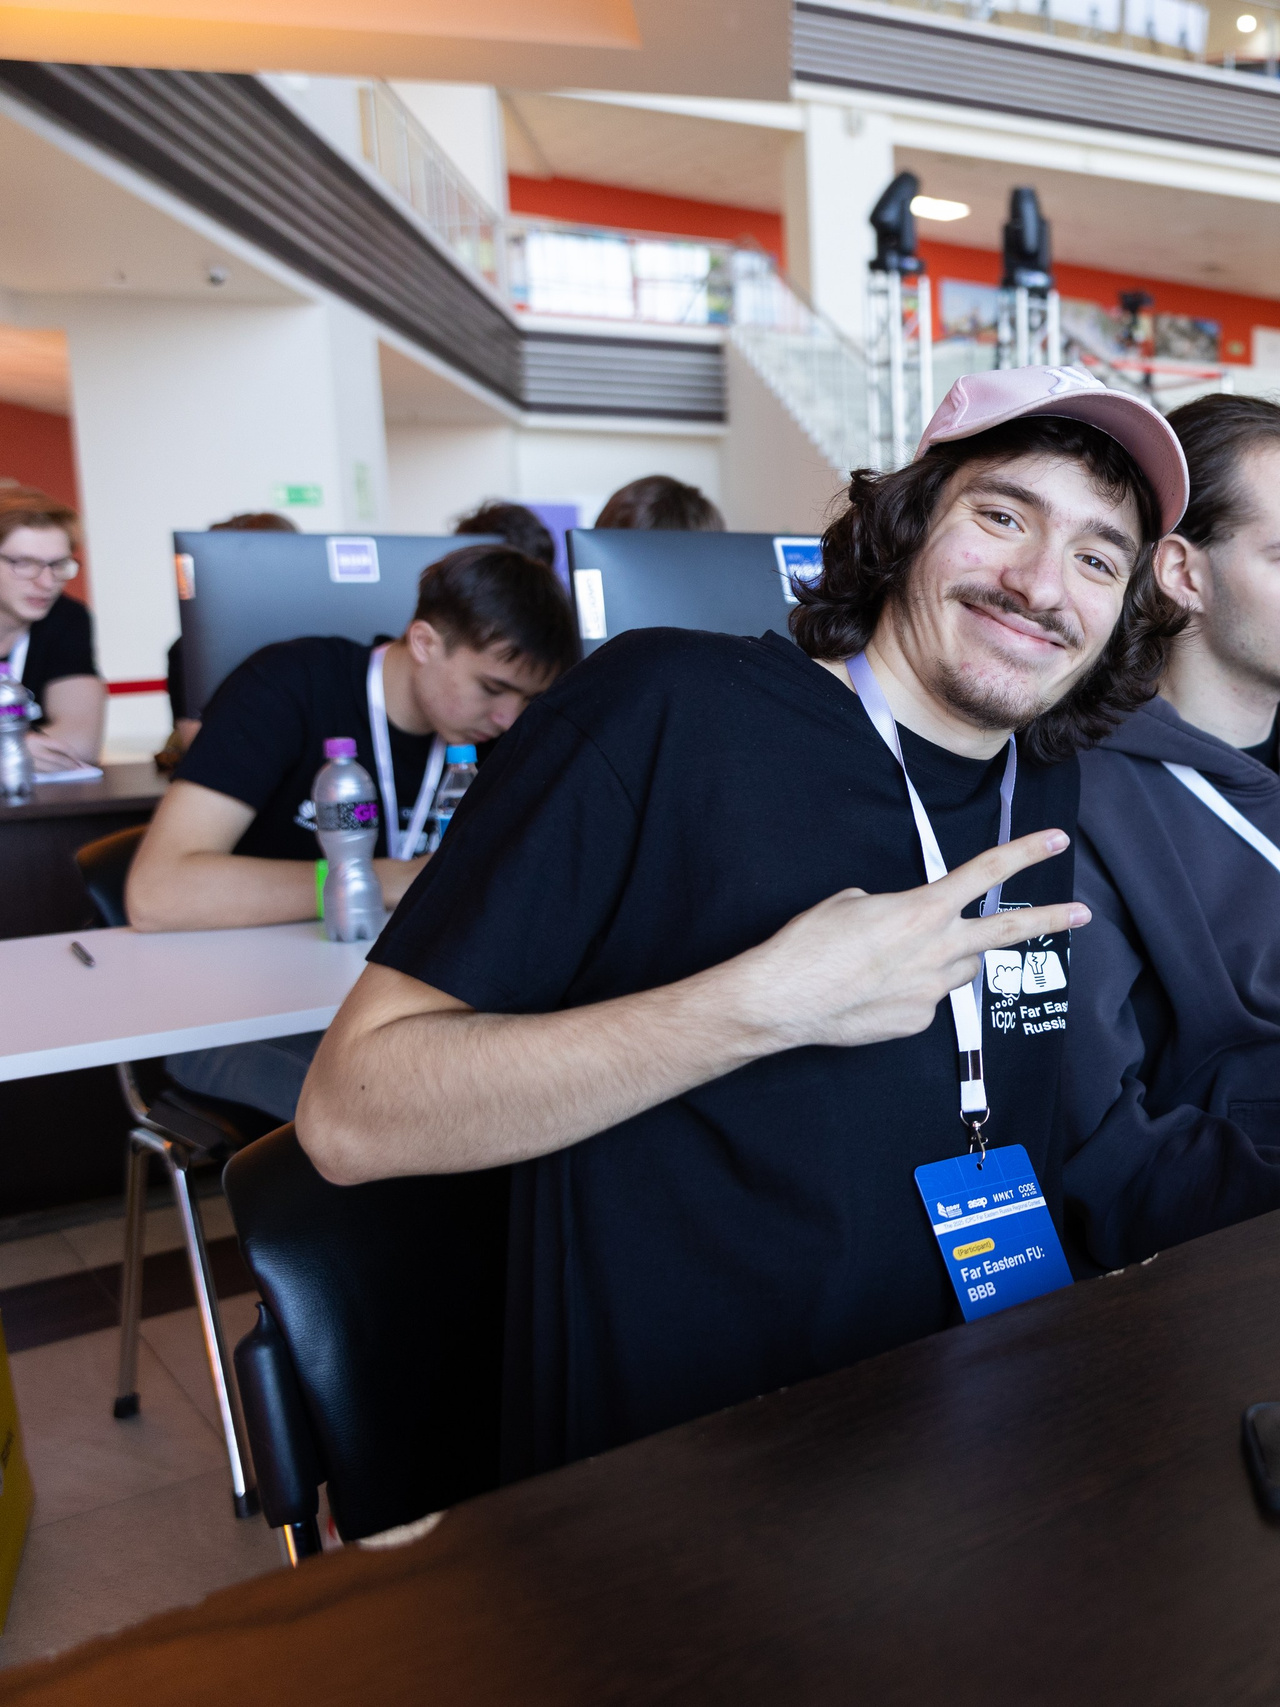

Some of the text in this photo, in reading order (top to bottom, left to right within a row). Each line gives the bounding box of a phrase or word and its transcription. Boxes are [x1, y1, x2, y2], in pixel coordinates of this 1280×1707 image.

[990, 1005, 1016, 1034] icpc
[1020, 1005, 1041, 1019] Far
[1018, 1182, 1037, 1194] CODE
[967, 1196, 988, 1208] asap
[957, 1240, 992, 1257] (Participant)
[960, 1245, 1046, 1283] Far Eastern FU:
[967, 1281, 997, 1303] BBB
